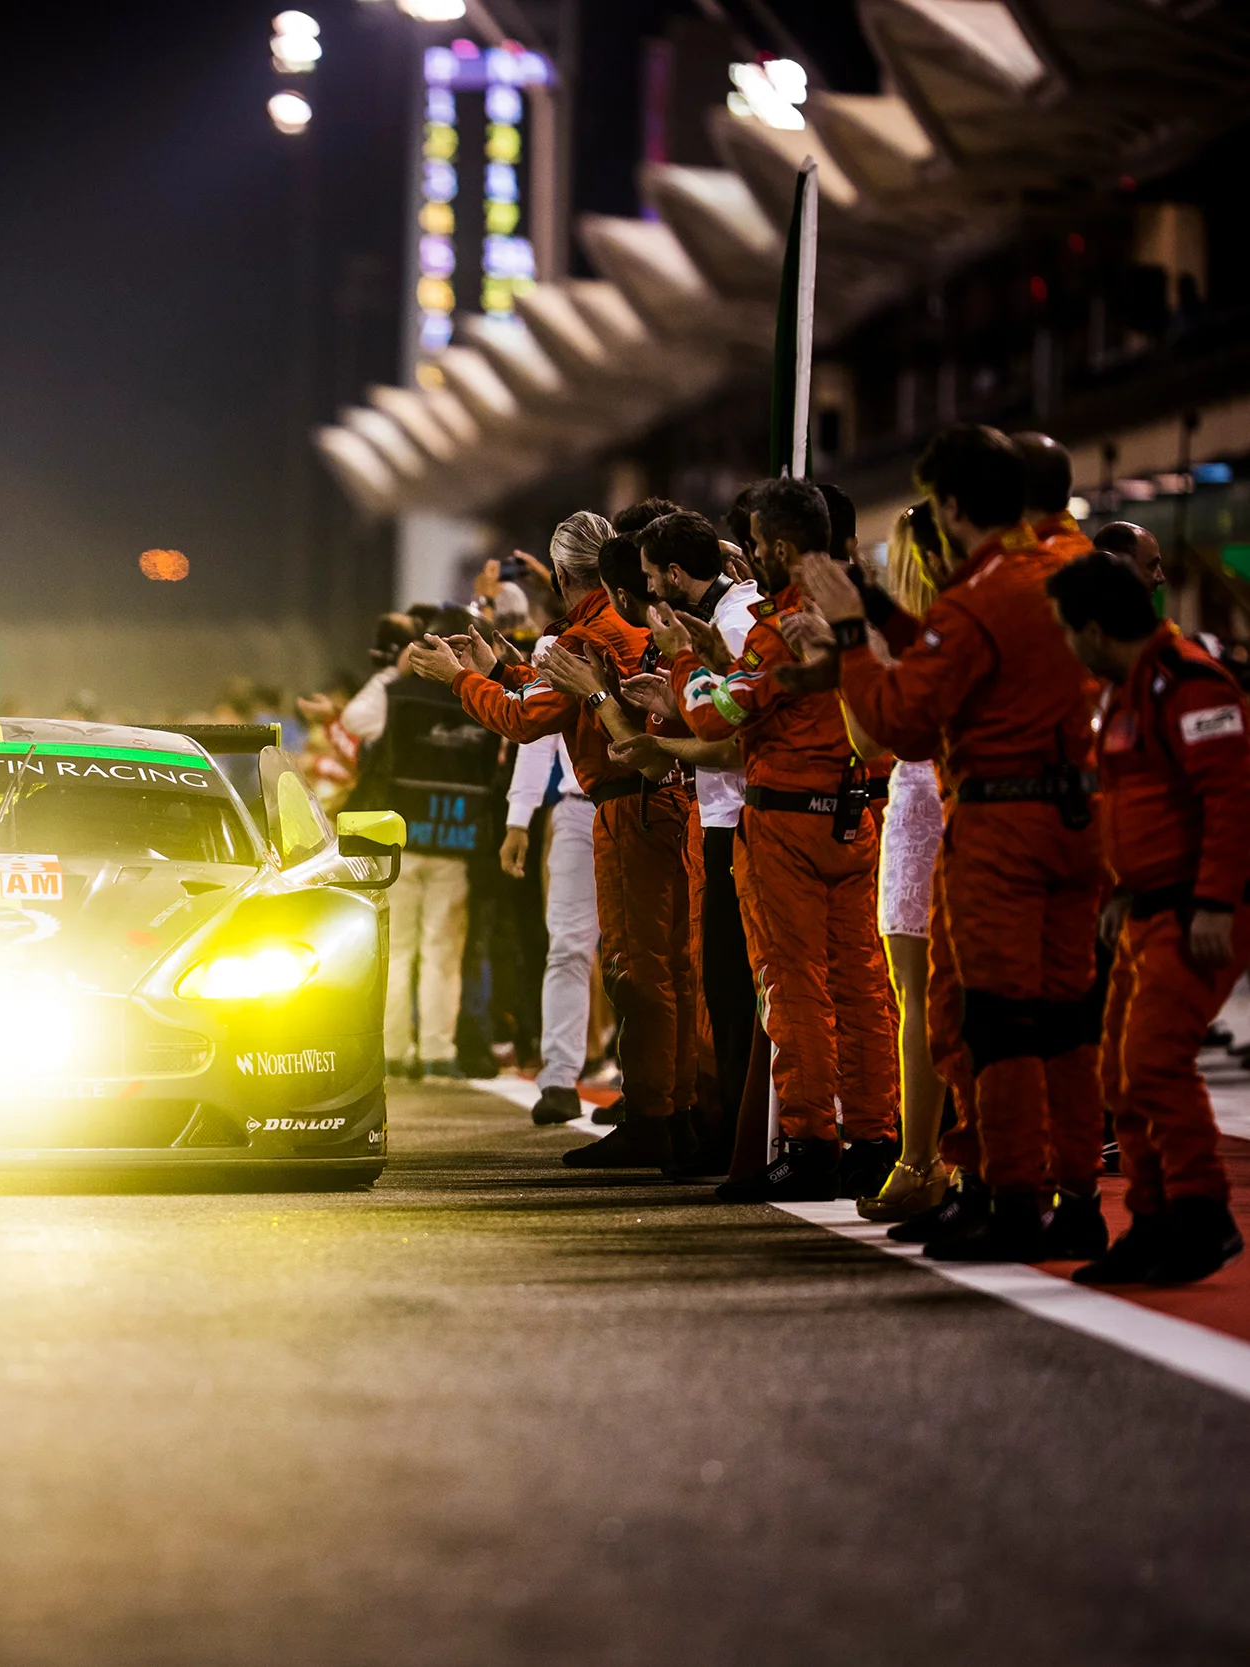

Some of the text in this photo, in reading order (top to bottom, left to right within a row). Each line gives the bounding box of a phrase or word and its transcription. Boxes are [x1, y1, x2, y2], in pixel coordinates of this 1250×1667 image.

[56, 761, 209, 788] RACING
[6, 873, 59, 895] AM
[263, 1118, 346, 1131] DUNLOP
[770, 1165, 790, 1181] OMP
